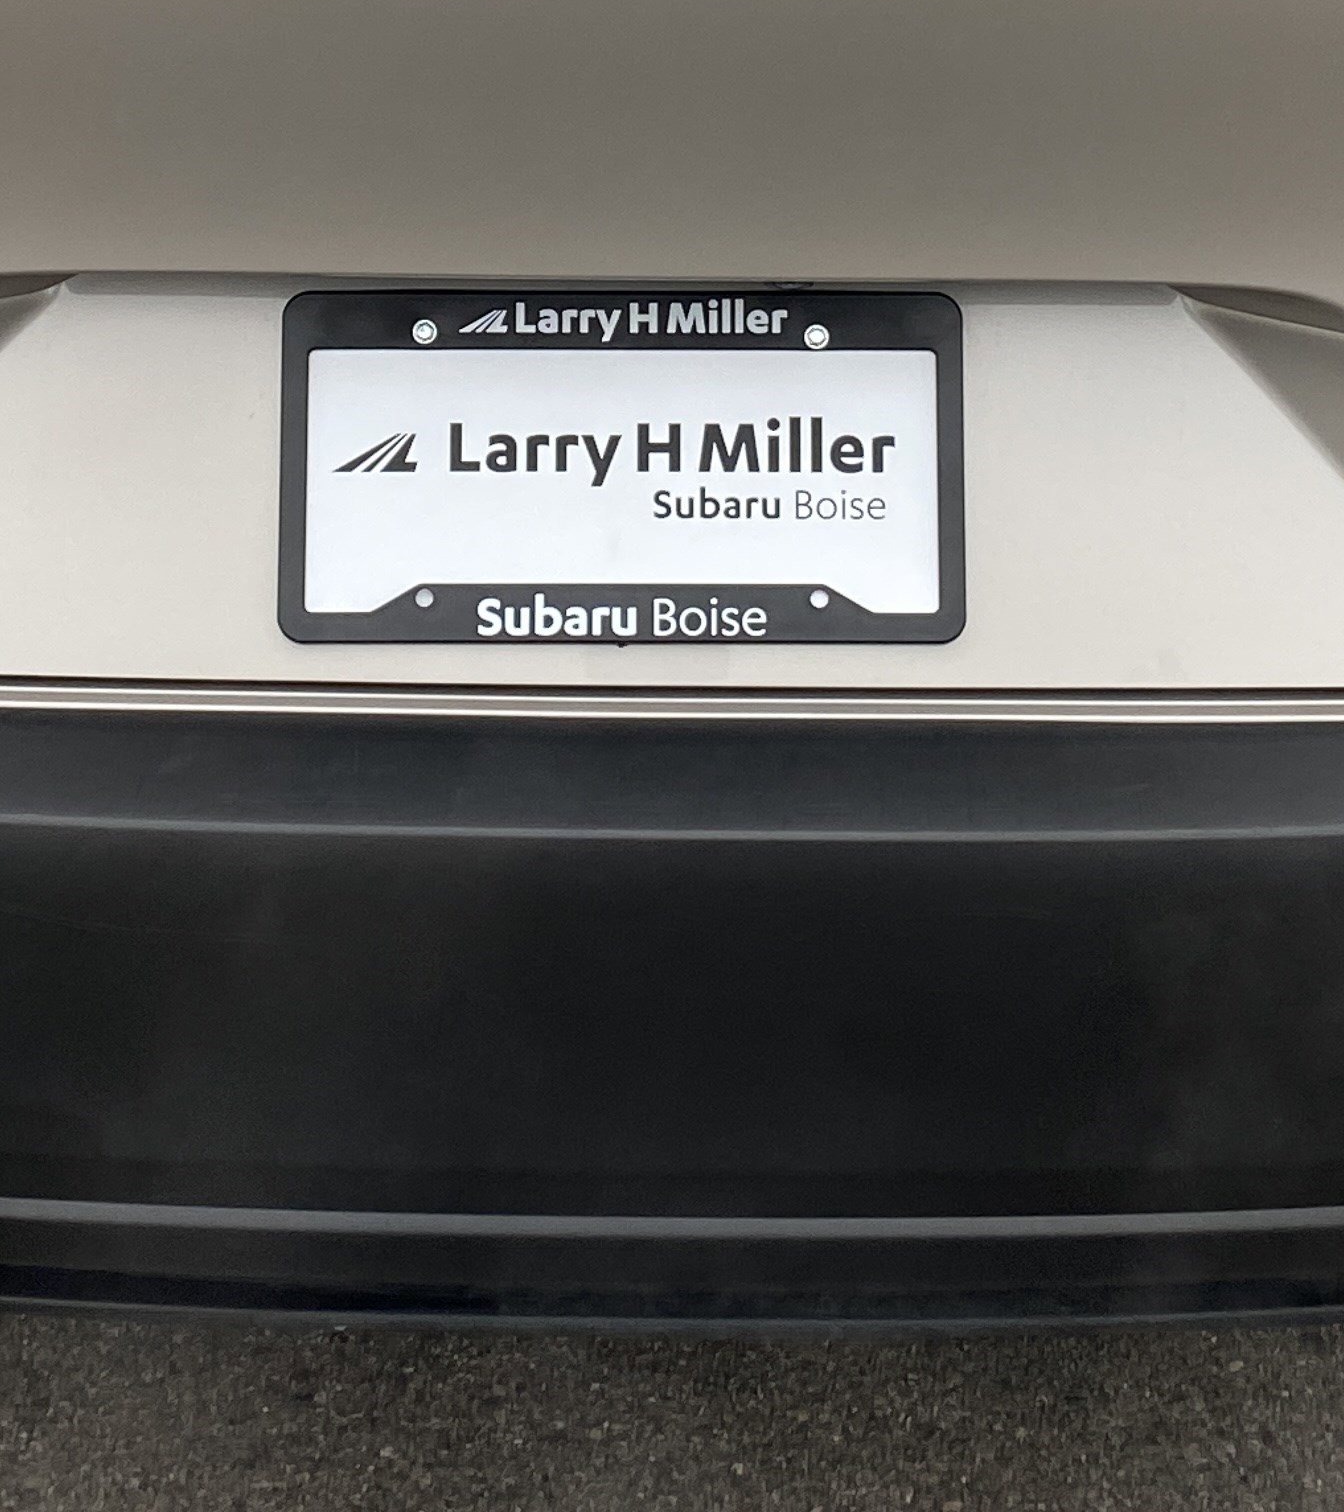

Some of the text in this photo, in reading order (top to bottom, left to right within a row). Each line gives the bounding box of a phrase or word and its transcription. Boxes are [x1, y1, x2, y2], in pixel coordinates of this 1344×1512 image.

[515, 298, 788, 343] Larry H Miller
[449, 416, 896, 487] Larry H Miller
[653, 487, 887, 521] Subaru Boise
[476, 592, 768, 637] Subaru Boise
